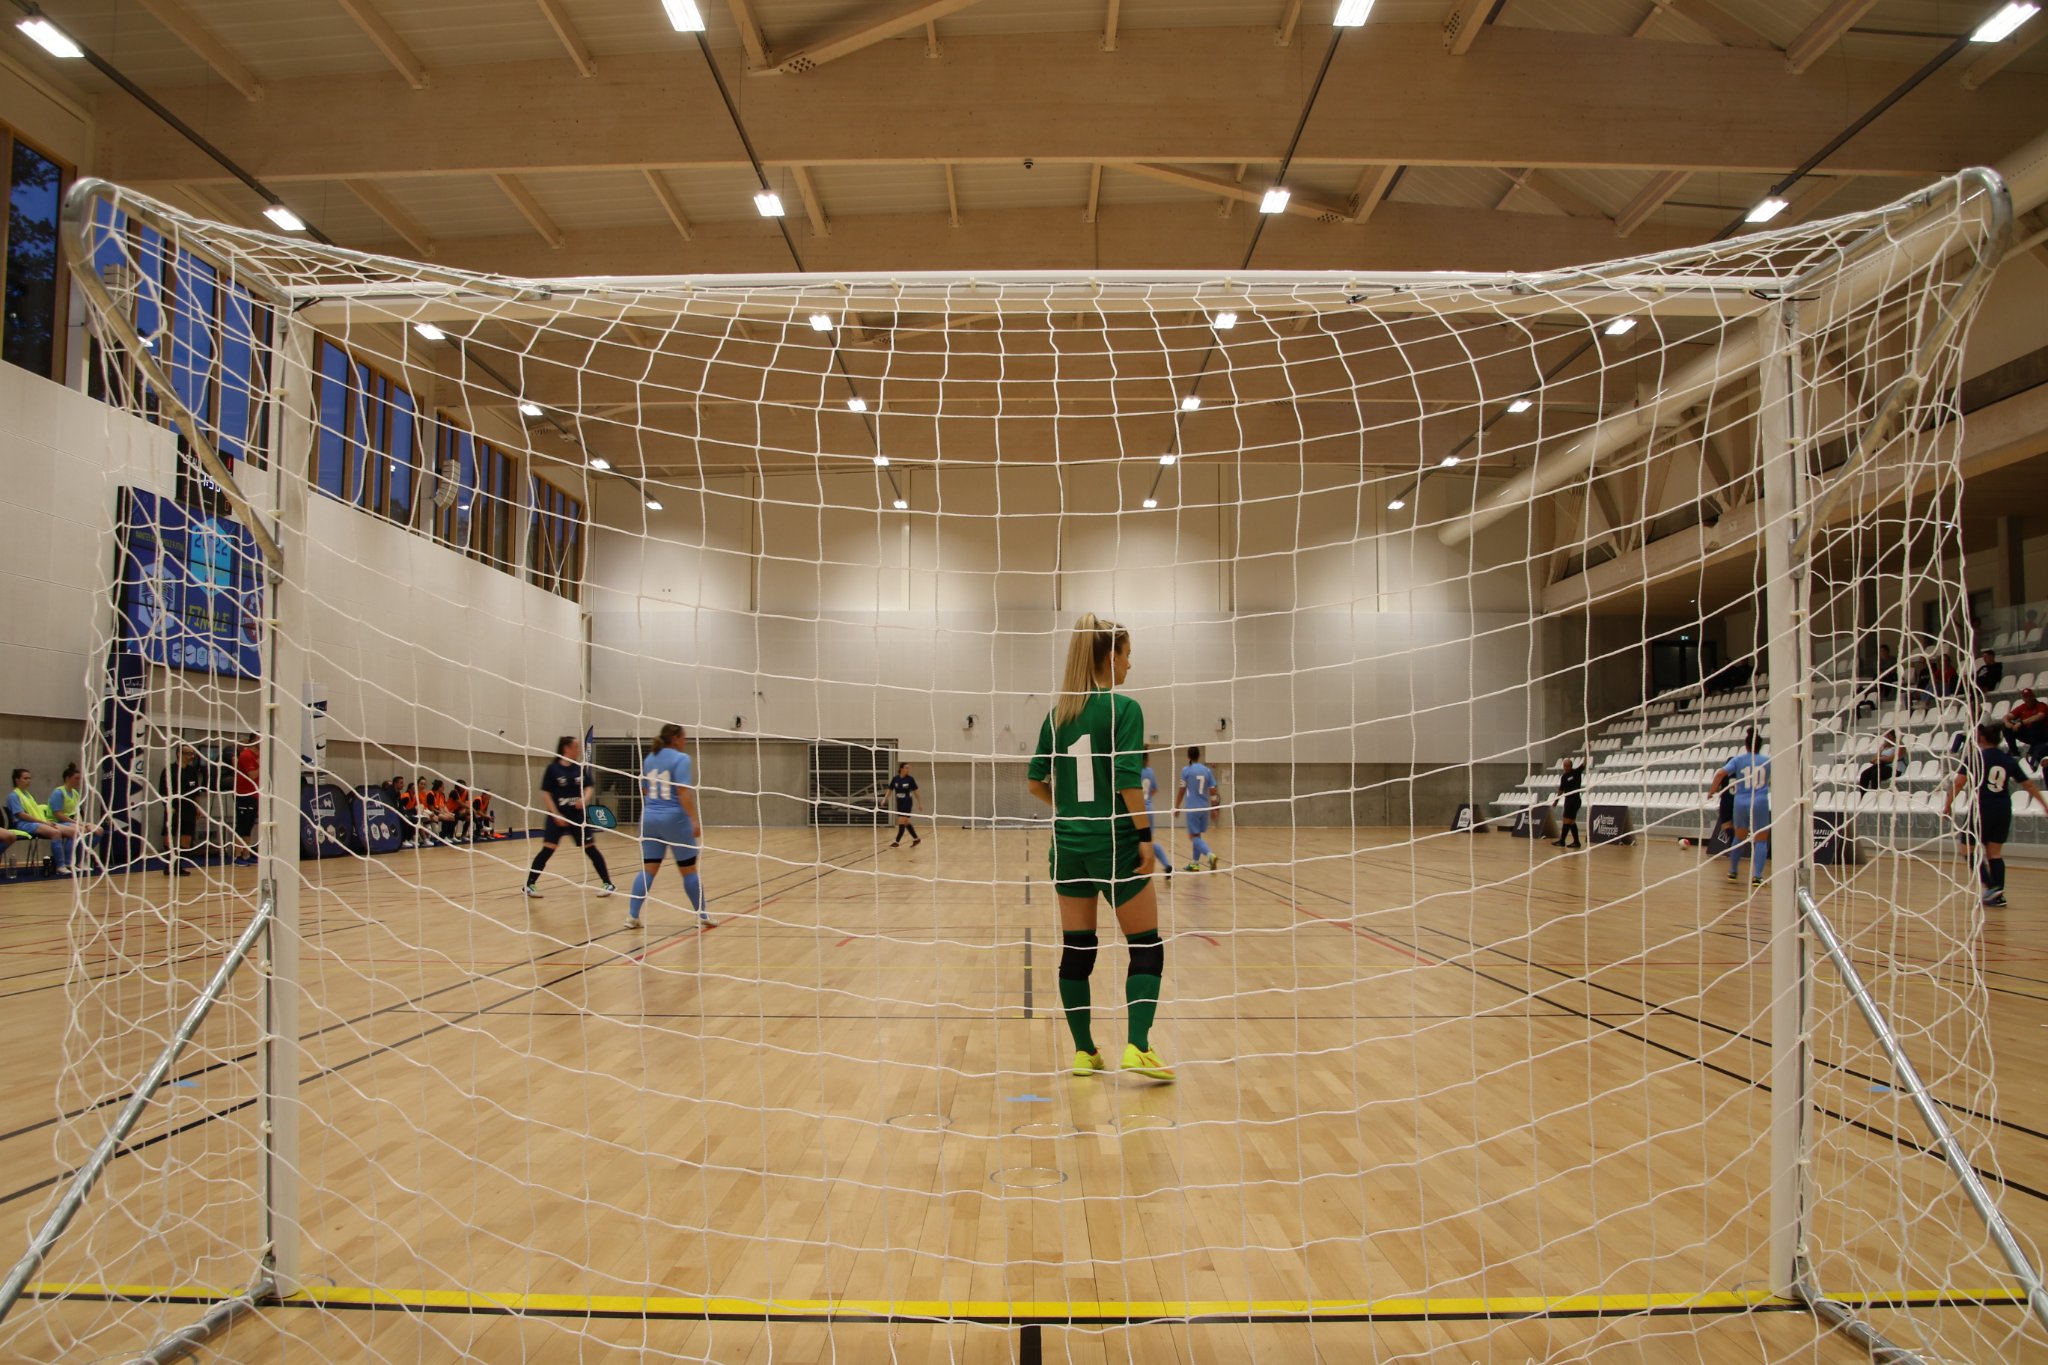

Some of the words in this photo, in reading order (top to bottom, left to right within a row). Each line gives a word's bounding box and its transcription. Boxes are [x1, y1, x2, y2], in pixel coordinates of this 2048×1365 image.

[1067, 733, 1095, 803] 1
[1739, 766, 1767, 790] 10
[1987, 765, 2007, 793] 9
[646, 768, 672, 801] 11
[1195, 774, 1206, 795] 7
